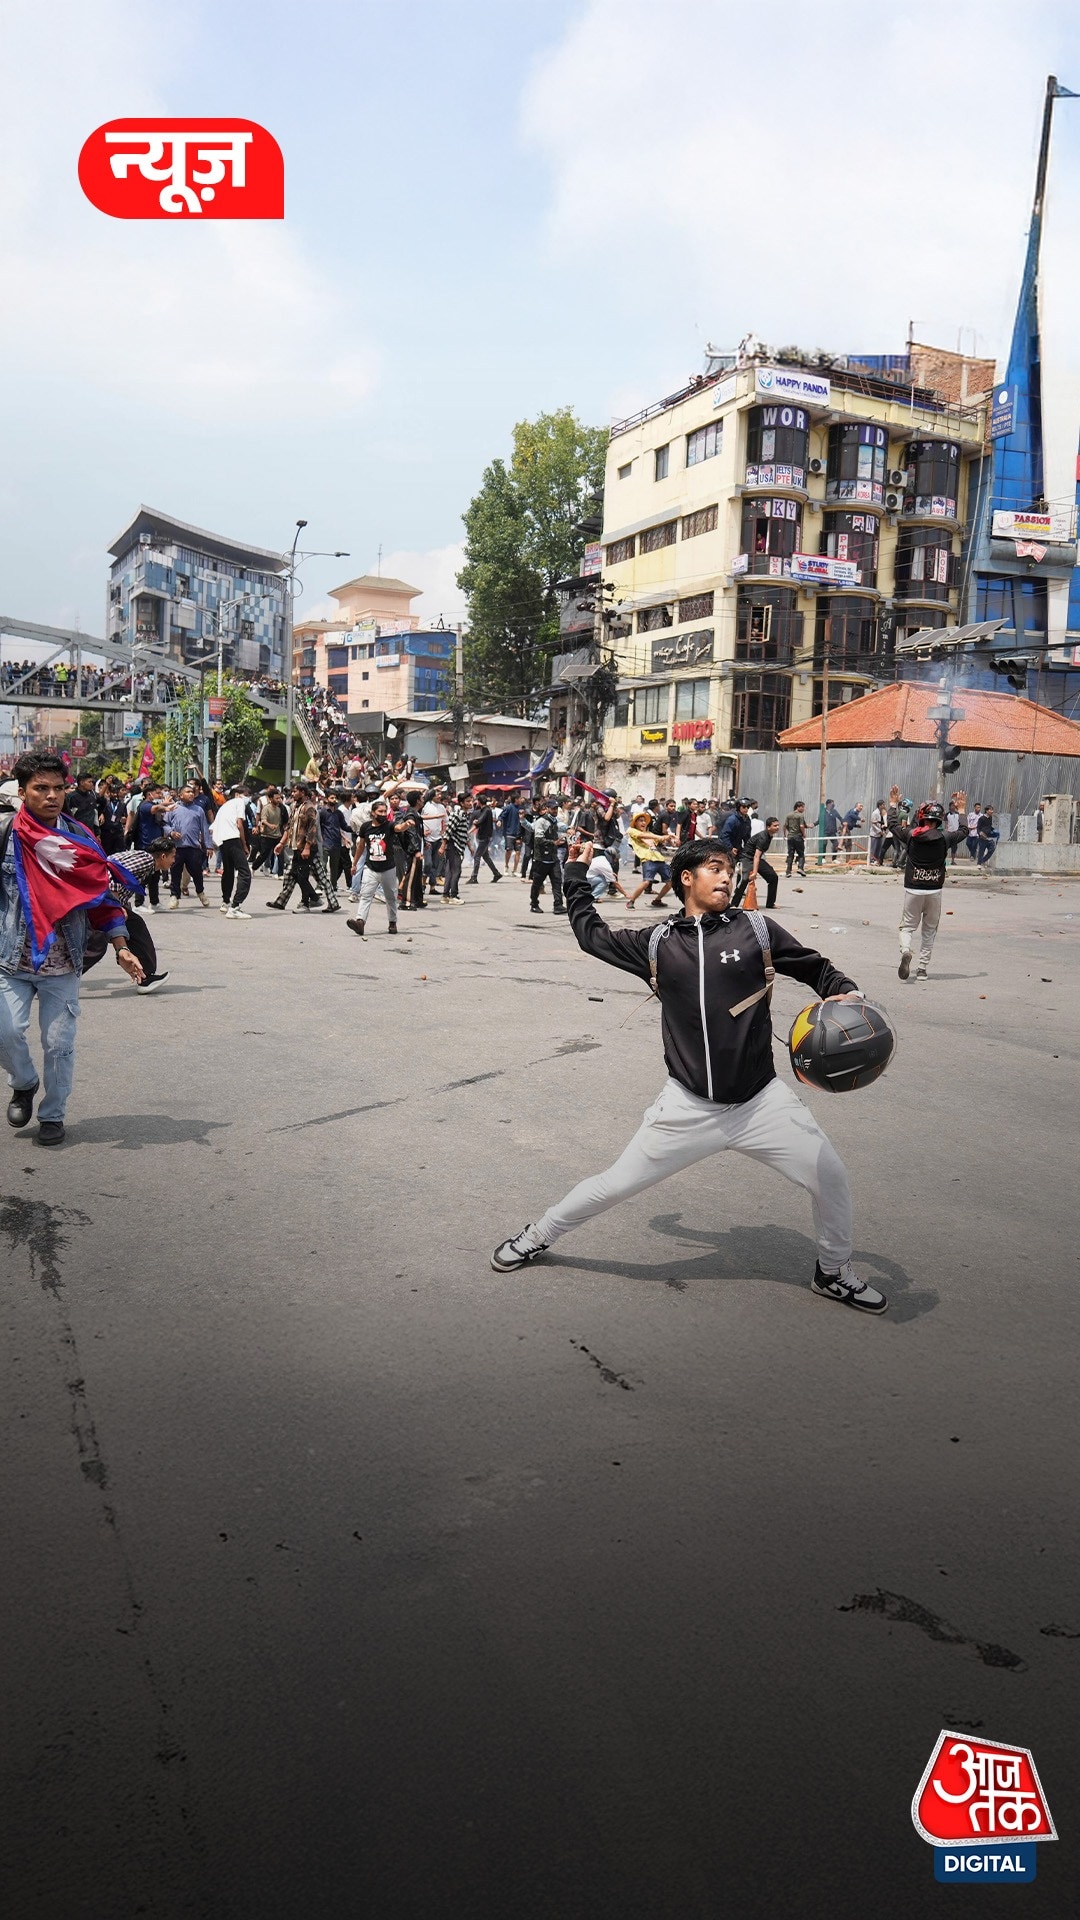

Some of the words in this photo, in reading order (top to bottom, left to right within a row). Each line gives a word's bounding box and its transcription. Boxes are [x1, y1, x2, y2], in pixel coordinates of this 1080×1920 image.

[775, 376, 801, 389] HAPPY
[802, 382, 828, 395] PANDA
[763, 407, 805, 429] WOR
[776, 466, 791, 474] IELTS
[759, 474, 774, 483] USA
[776, 475, 791, 485] PTE
[793, 477, 802, 486] UK
[857, 491, 870, 499] KOREA
[1014, 515, 1051, 525] PASSION
[840, 535, 848, 560] PTE
[771, 557, 779, 573] USA
[939, 551, 947, 581] WORK
[675, 634, 695, 662] Cafe
[672, 720, 713, 740] AMIGO
